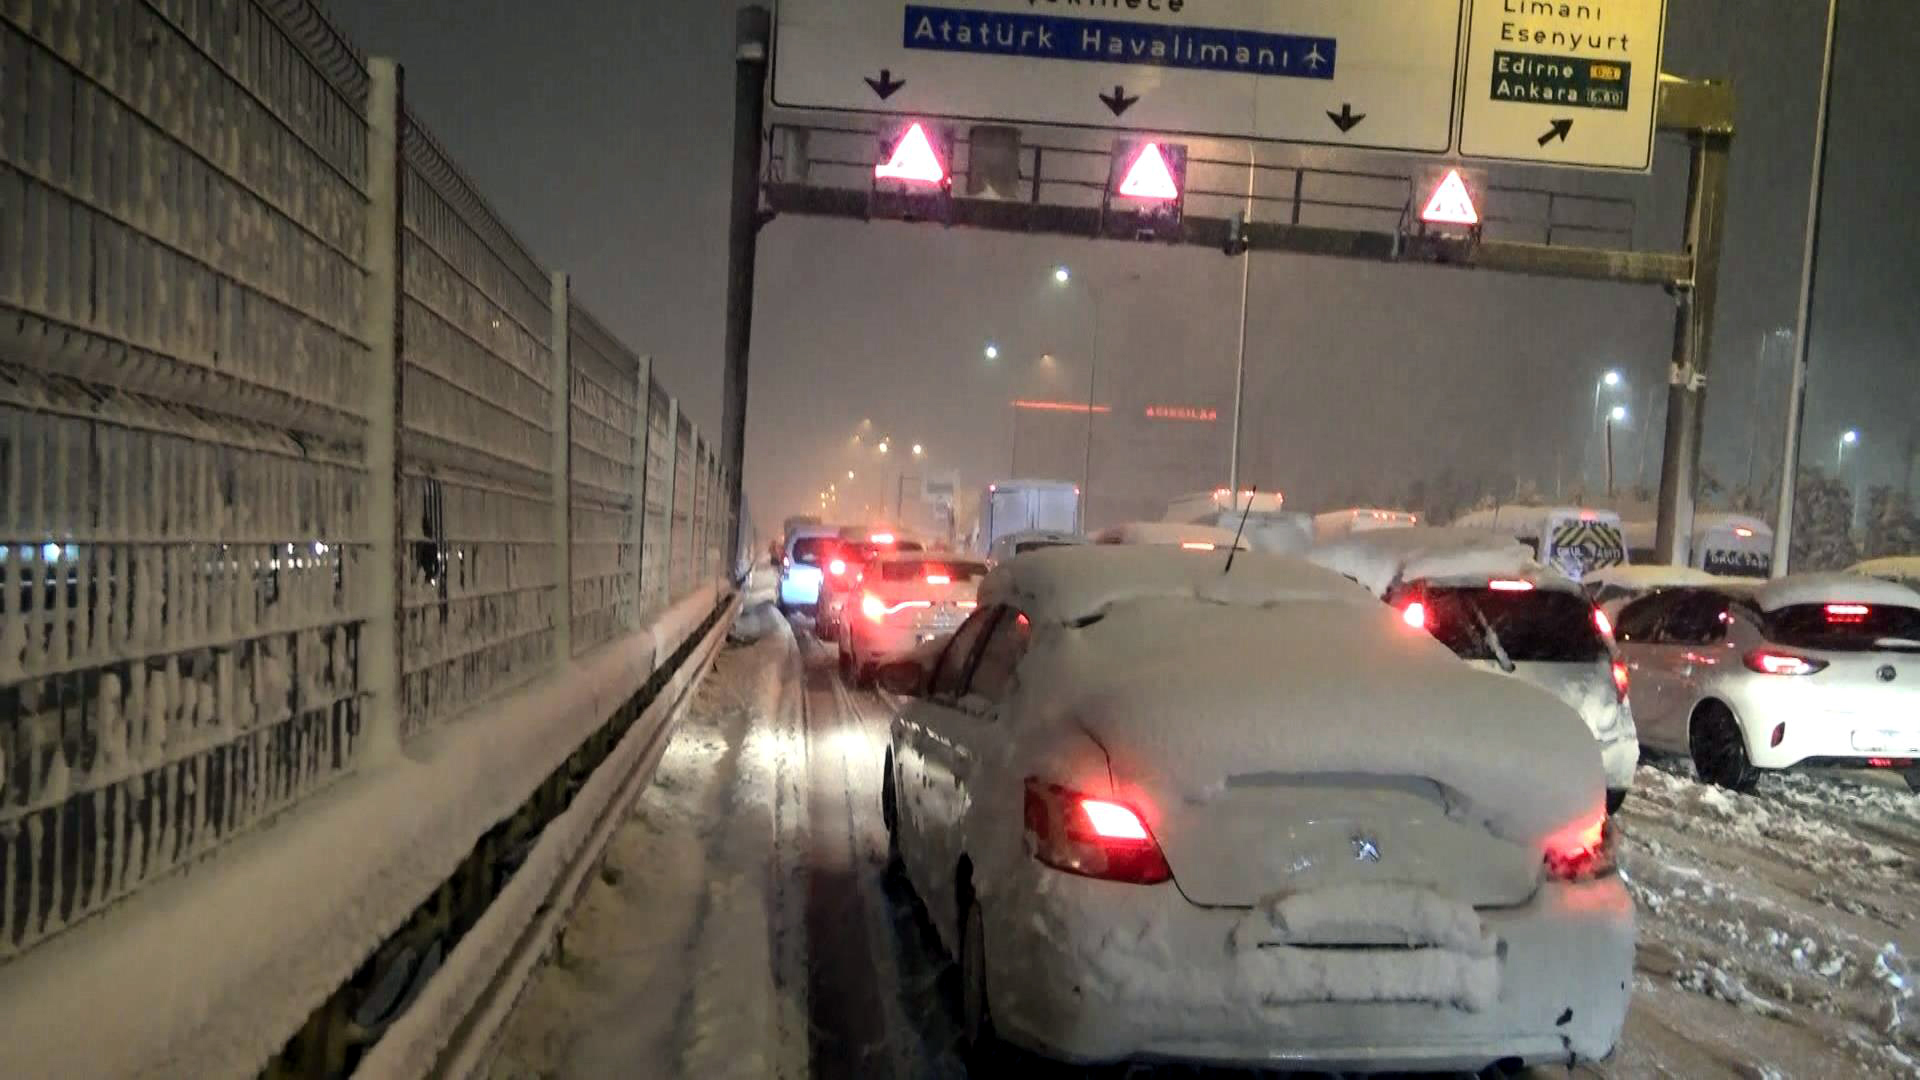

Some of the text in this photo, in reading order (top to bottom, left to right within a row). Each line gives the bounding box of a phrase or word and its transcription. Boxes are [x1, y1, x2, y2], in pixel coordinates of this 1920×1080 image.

[913, 15, 1288, 68] Atatürk Havalimanı
[1501, 22, 1629, 51] Esenyurt
[1498, 56, 1574, 78] Edirne
[1496, 79, 1578, 102] Ankara
